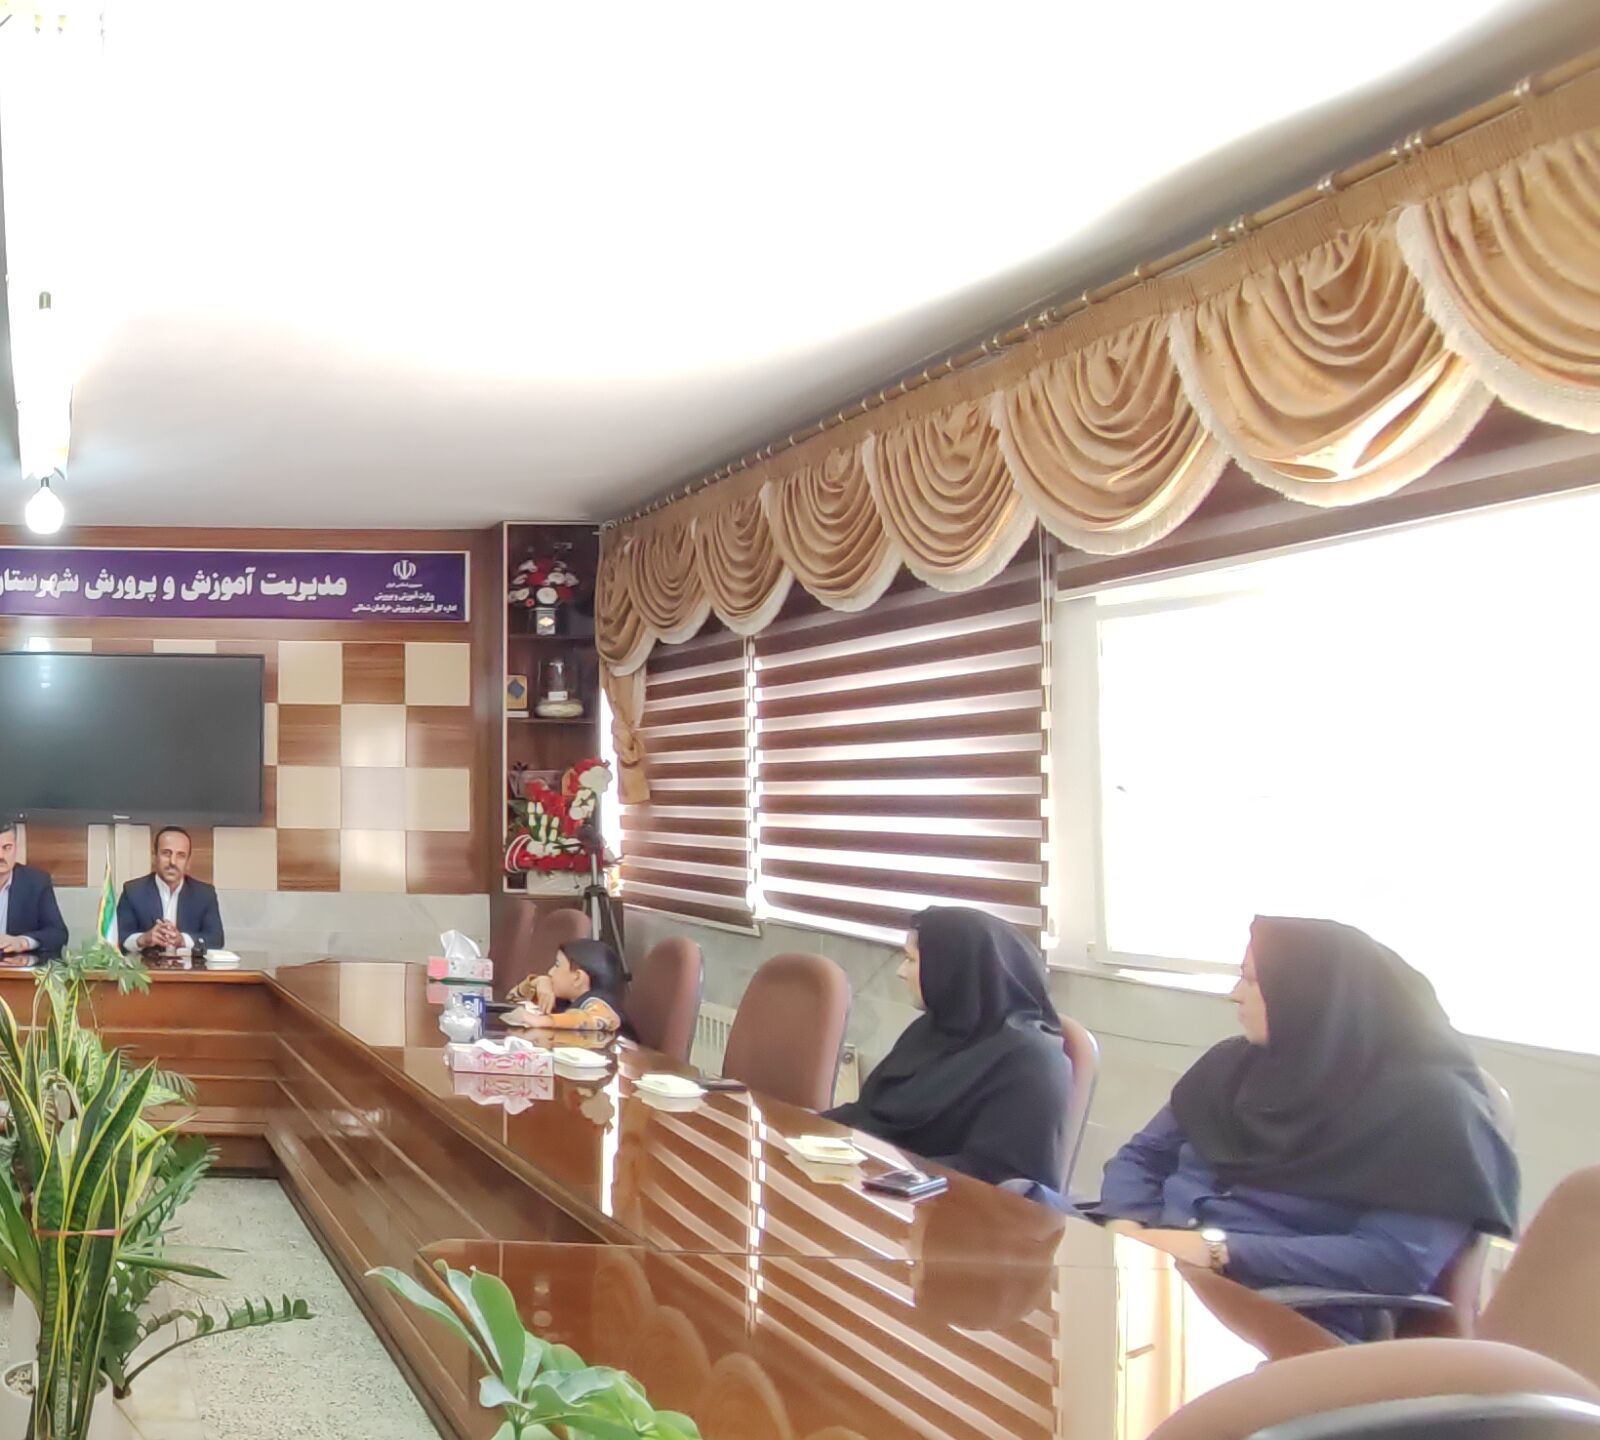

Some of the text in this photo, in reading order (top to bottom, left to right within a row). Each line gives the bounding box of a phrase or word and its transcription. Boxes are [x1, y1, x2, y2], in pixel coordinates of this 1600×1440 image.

[84, 568, 158, 602] پرورش
[162, 575, 176, 600] و
[180, 566, 257, 601] آموزش
[260, 572, 347, 602] مدیریت
